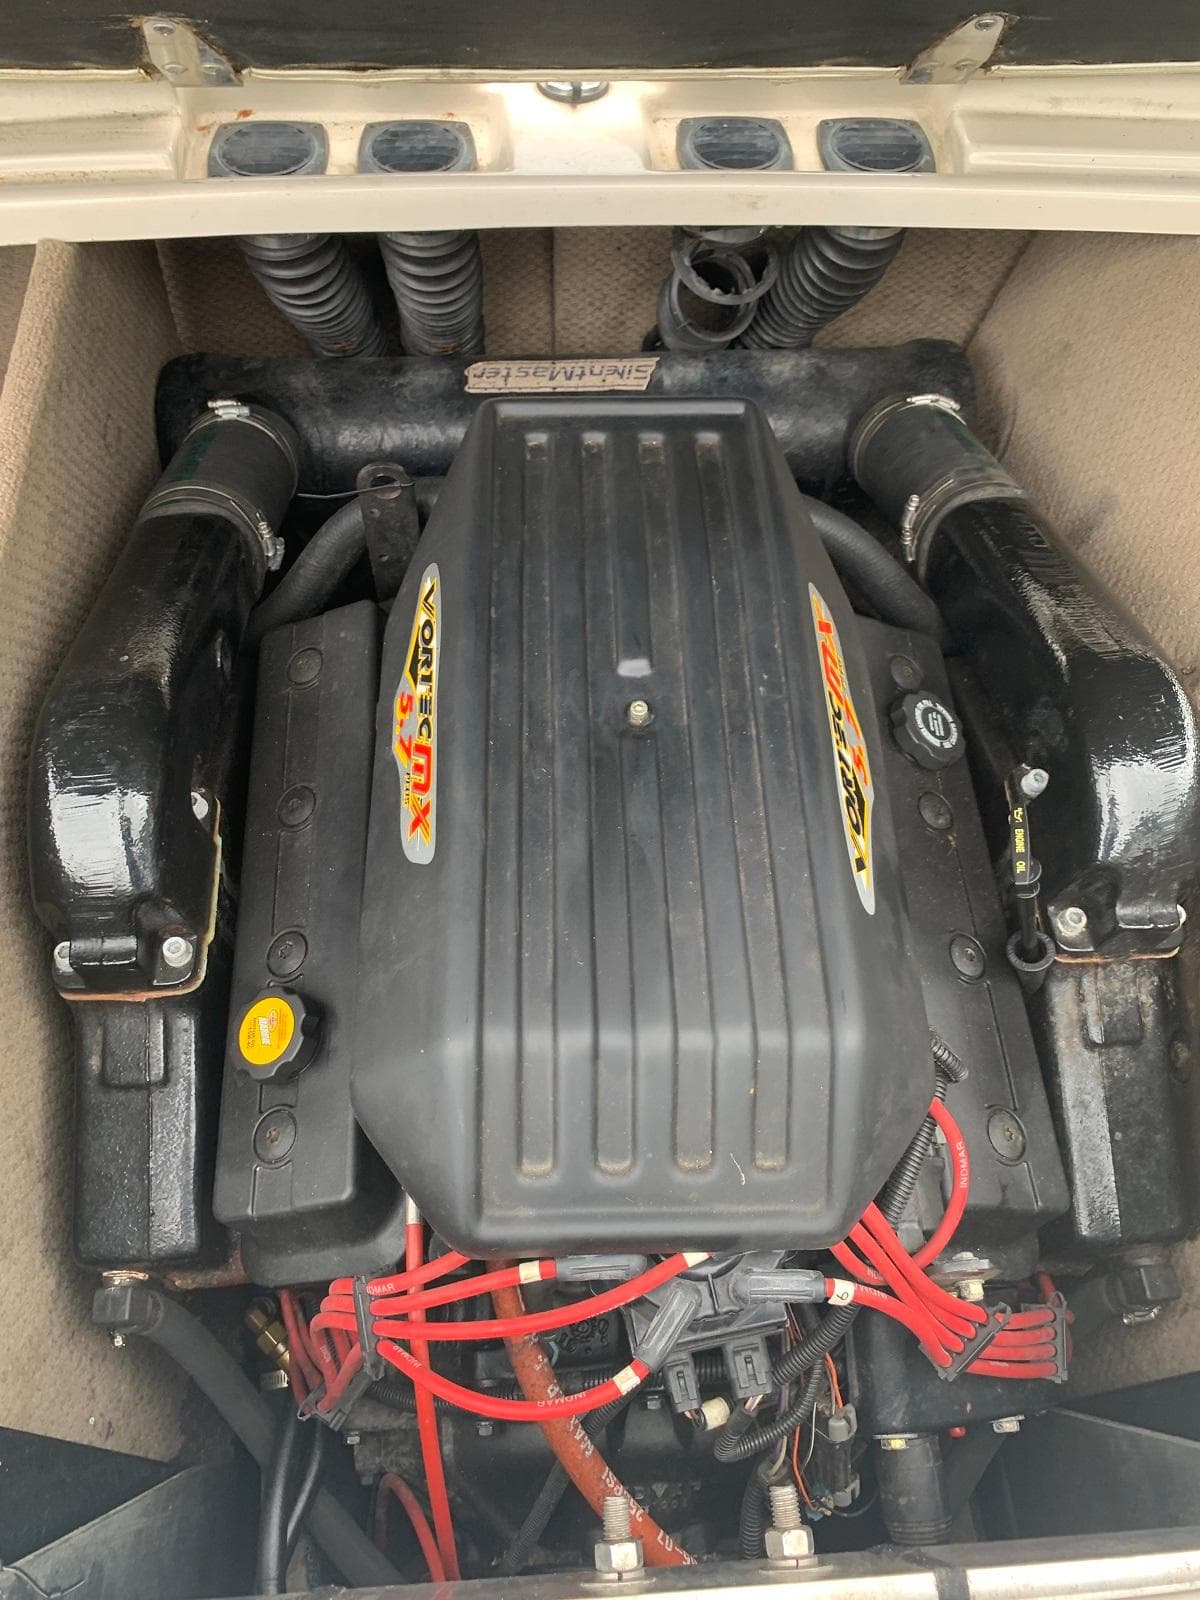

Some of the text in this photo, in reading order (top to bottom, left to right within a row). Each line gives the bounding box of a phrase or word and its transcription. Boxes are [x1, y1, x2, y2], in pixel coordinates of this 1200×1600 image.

[417, 578, 437, 740] VORTEC
[1014, 828, 1026, 874] ENGINE OIL
[955, 1140, 969, 1189] INDMAR
[536, 1392, 587, 1407] INDMAR
